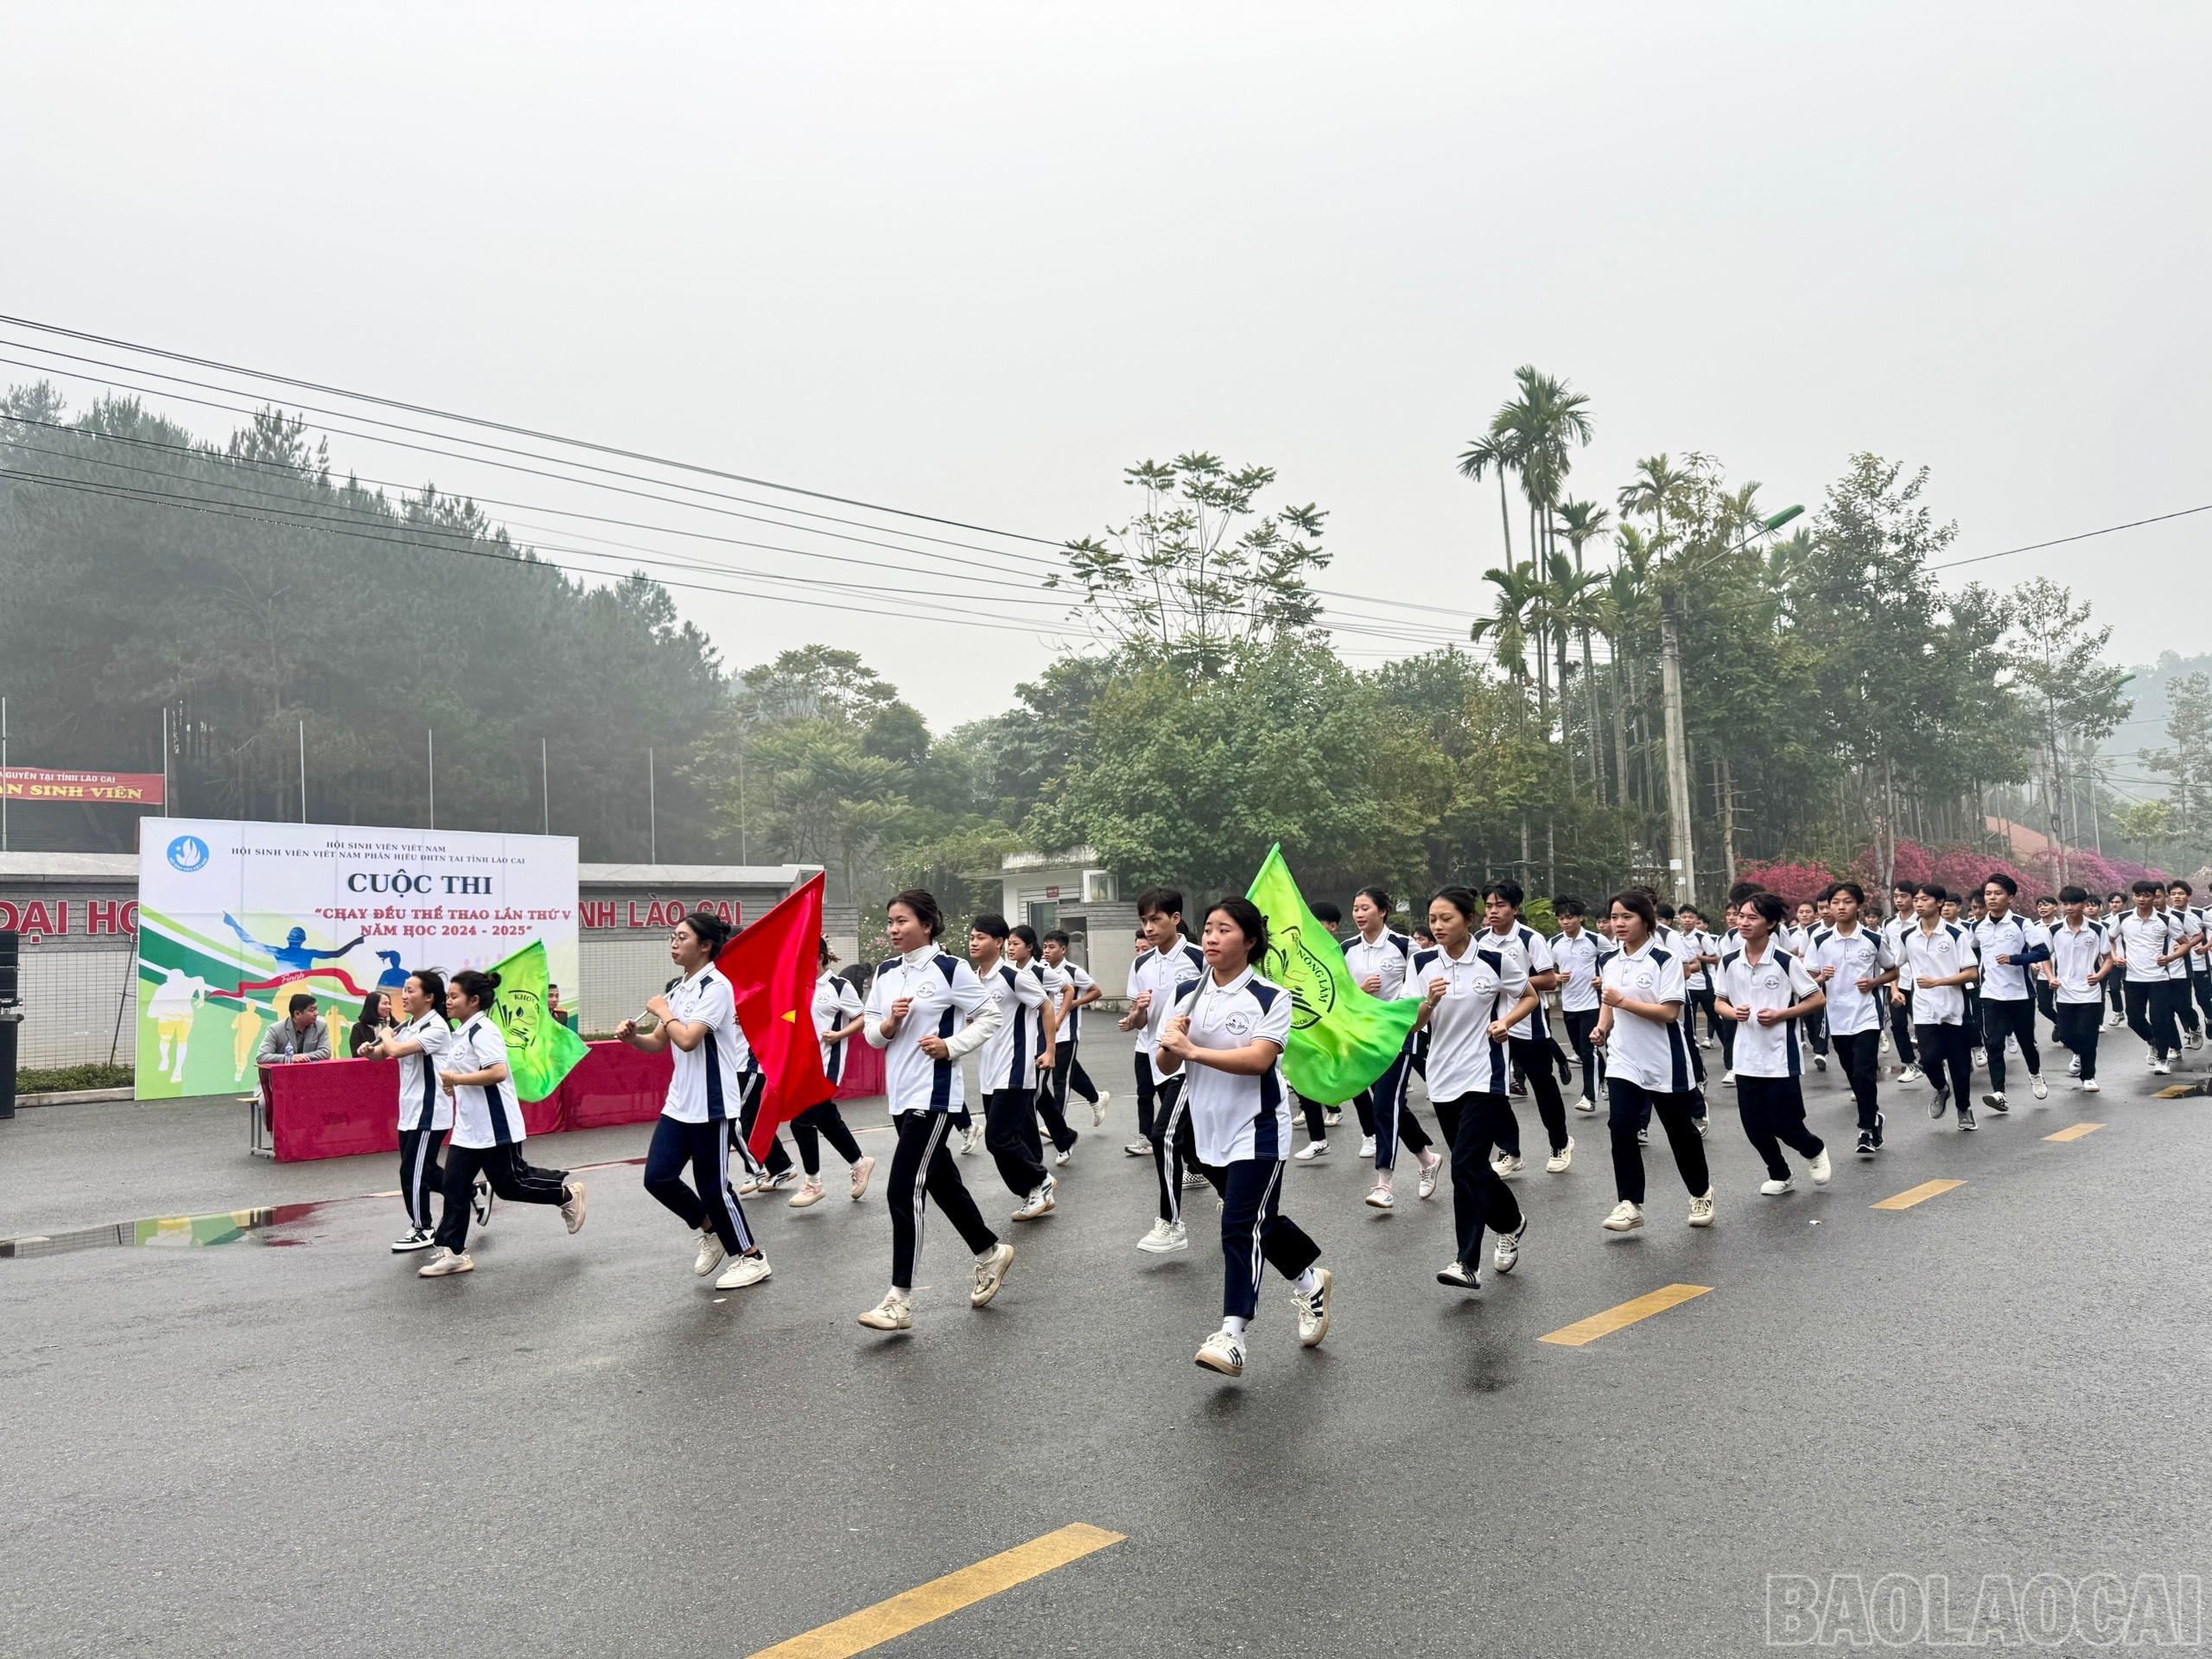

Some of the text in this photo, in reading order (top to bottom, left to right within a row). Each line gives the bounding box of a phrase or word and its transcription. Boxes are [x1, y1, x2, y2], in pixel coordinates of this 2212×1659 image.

[40, 772, 54, 782] TẠI
[29, 785, 84, 798] SINH
[90, 785, 143, 799] VIÊN
[232, 846, 251, 856] HỘI
[255, 848, 281, 856] SINH
[285, 849, 309, 857] VIÊN
[313, 849, 336, 859] VIỆT
[327, 840, 446, 853] HỘI SINH VIÊN VIỆT NAM
[347, 868, 493, 898] CUỘC THI
[411, 905, 443, 919] THỂ
[448, 909, 490, 920] THAO
[527, 908, 559, 920] THỨ
[562, 910, 572, 920] V
[627, 893, 686, 928] LÀO
[360, 922, 397, 936] NĂM
[403, 925, 436, 938] HỌC
[442, 925, 477, 936] 2024
[281, 970, 305, 984] Finish
[1297, 949, 1332, 1003] NÔNG LÂM
